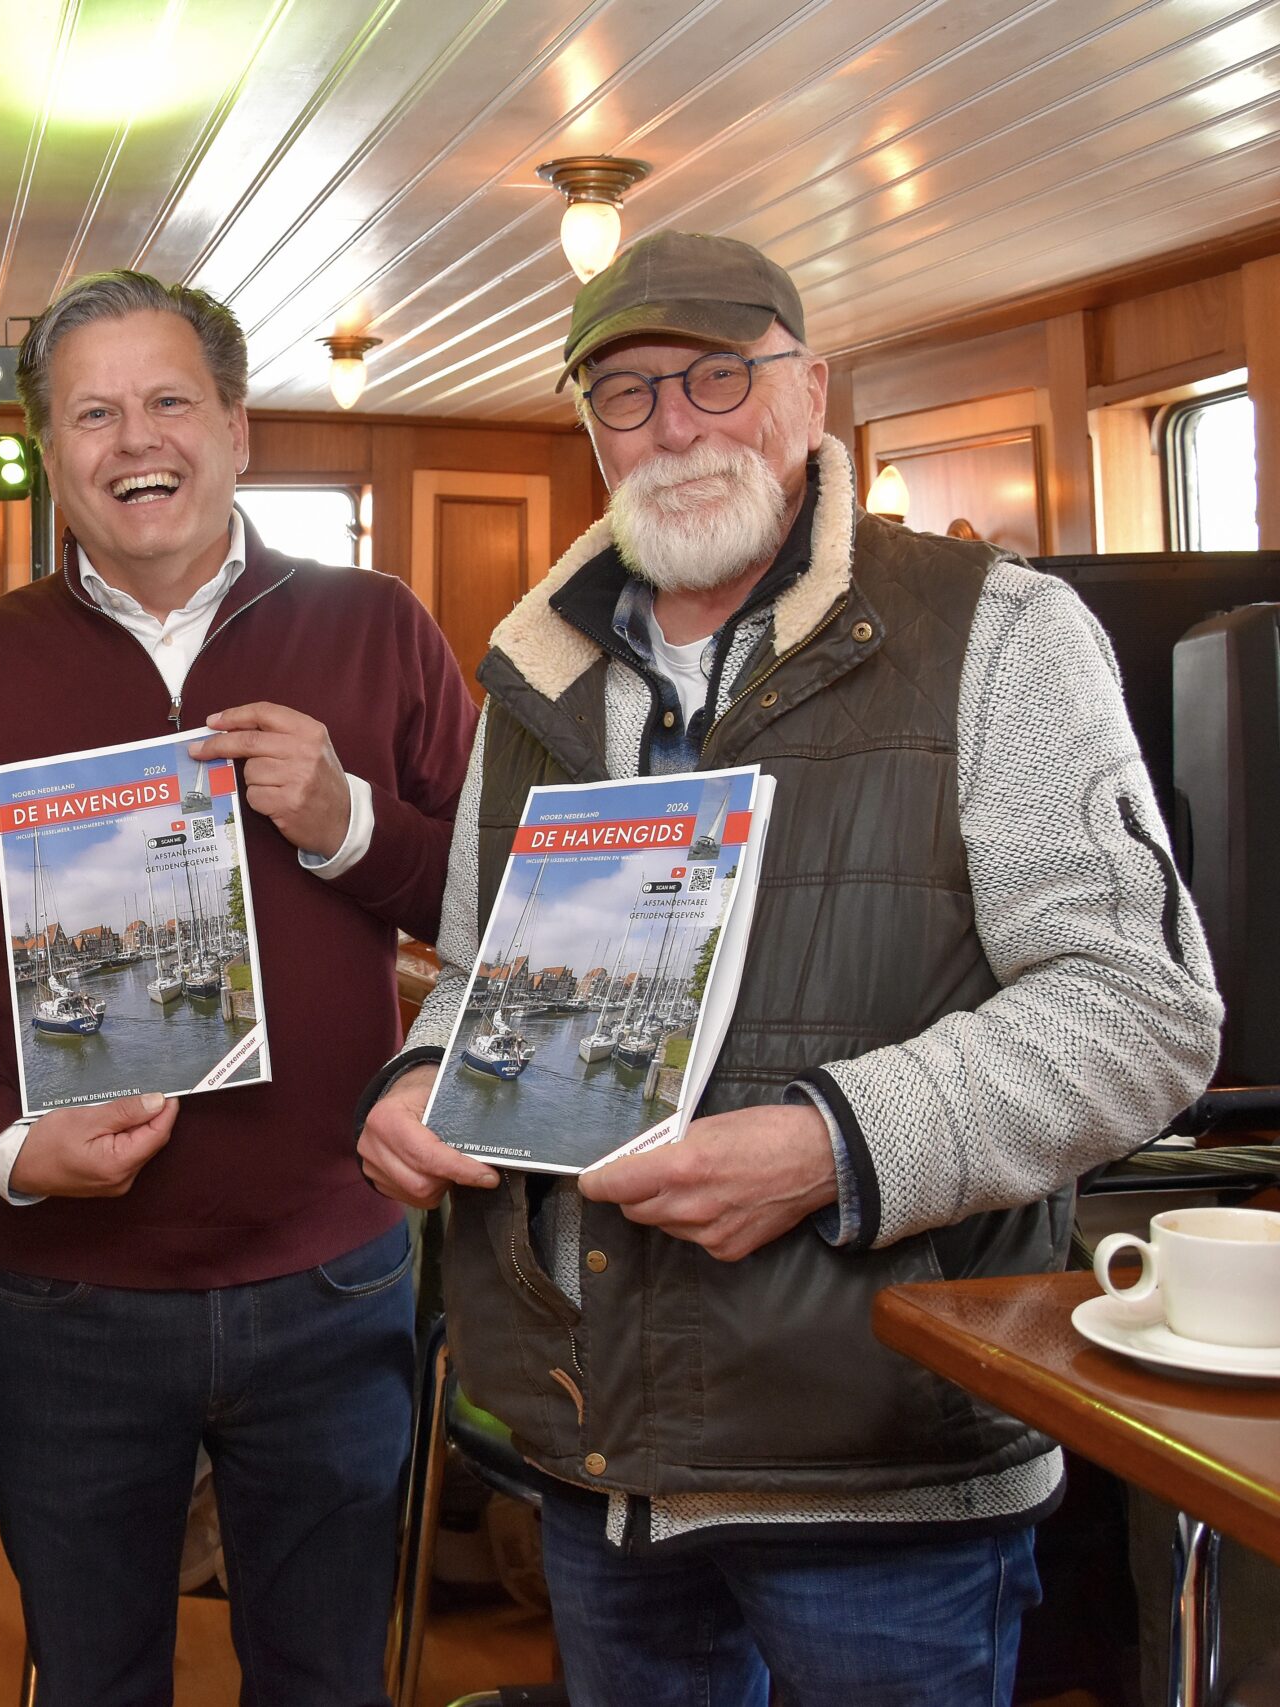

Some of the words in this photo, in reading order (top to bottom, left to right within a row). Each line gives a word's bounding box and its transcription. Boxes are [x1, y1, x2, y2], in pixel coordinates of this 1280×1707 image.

[143, 765, 166, 776] 2026
[12, 789, 36, 799] NOORD
[37, 783, 75, 794] NEDERLAND
[13, 806, 38, 825] DE
[46, 784, 170, 819] HAVENGIDS
[666, 802, 689, 813] 2026
[564, 811, 599, 820] NEDERLAND
[73, 822, 105, 832] RANDMEREN
[531, 830, 558, 848] DE
[561, 823, 684, 847] HAVENGIDS
[154, 845, 218, 860] AFSTANDENTABEL
[145, 856, 219, 873] GETIJDENGEGEVENS
[207, 1067, 227, 1086] Gratis
[226, 1036, 257, 1068] exemplaar
[72, 1088, 141, 1103] WWW.DEHAVENGIDS.NL
[630, 1126, 671, 1155] exemplaar
[464, 1143, 532, 1158] WWW.DEHAVENGIDS.NL
